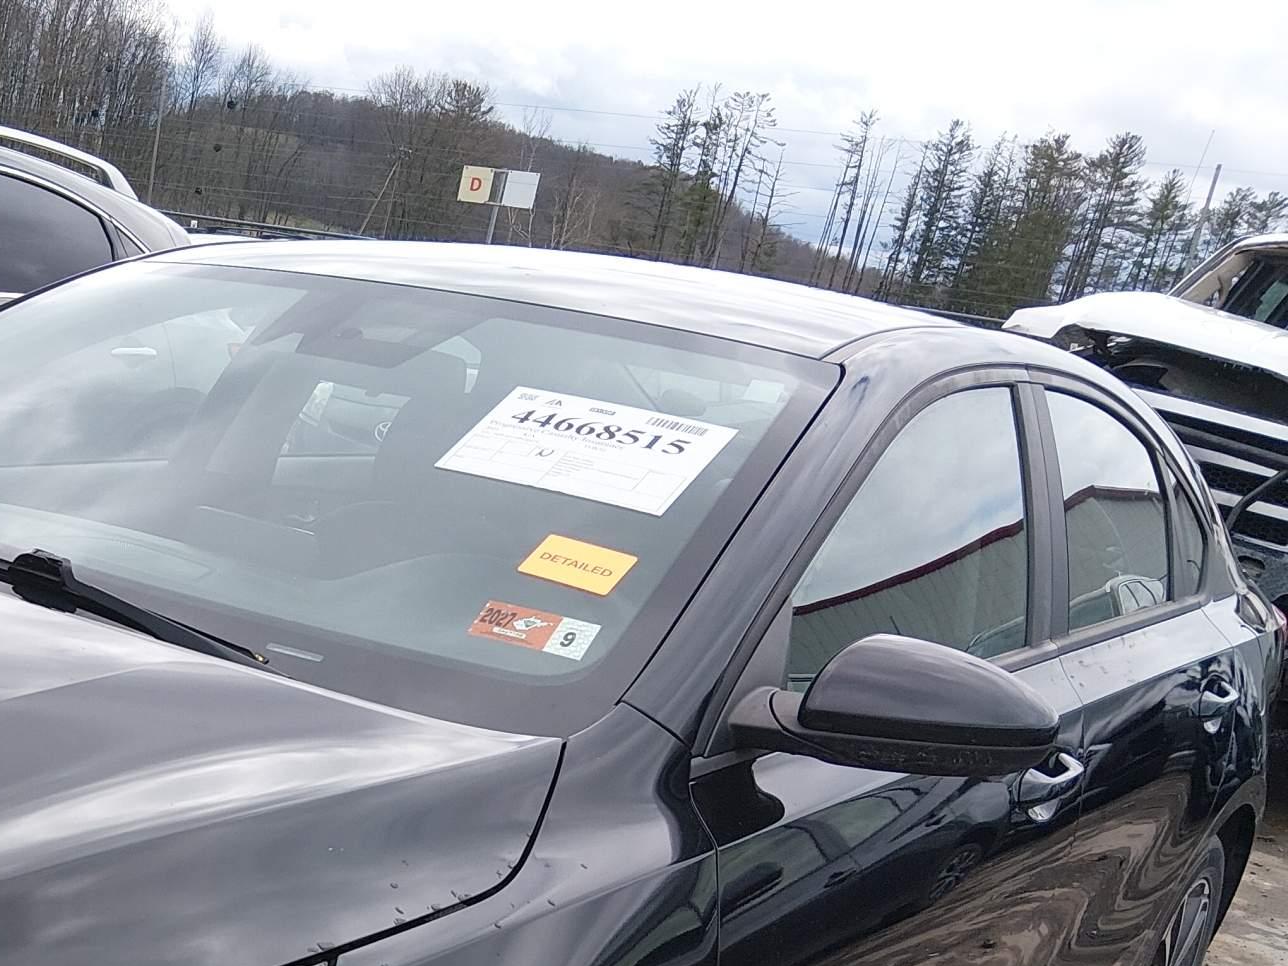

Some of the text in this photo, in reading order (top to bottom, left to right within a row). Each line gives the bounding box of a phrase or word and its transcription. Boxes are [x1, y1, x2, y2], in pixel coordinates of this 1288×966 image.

[469, 176, 483, 192] D
[511, 408, 692, 456] 44668515
[539, 551, 614, 578] DETAILED
[478, 607, 518, 629] 2027
[559, 631, 577, 648] 9
